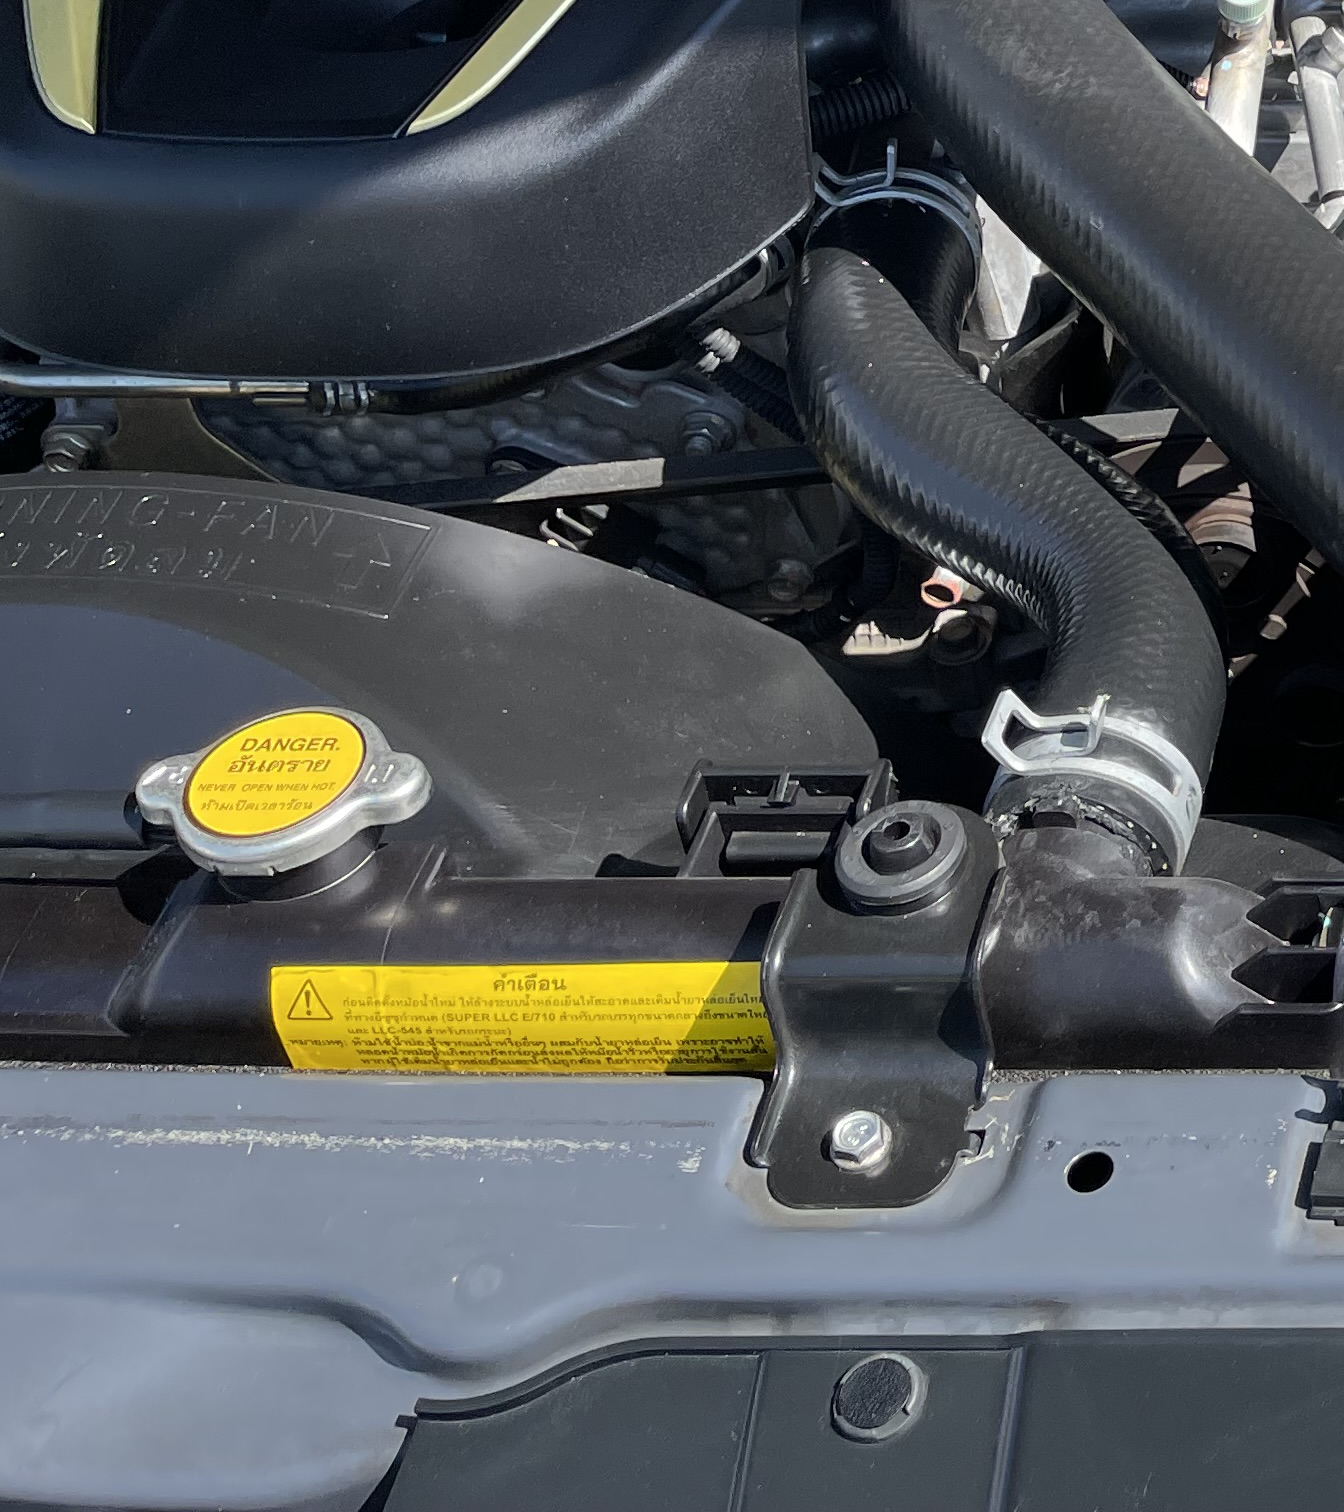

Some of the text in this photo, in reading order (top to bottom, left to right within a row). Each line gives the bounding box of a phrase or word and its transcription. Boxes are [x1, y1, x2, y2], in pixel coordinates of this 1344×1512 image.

[0, 490, 336, 546] NING-FAN
[240, 737, 341, 752] DANGER.
[227, 754, 332, 774] อันตราย
[197, 782, 237, 793] NEVER
[240, 782, 274, 793] OPEN
[275, 782, 308, 792] WHEN
[200, 798, 314, 813] ห้ามเปิดเวลาร้อน
[493, 973, 568, 992] คำเตือน
[343, 994, 456, 1008] ก่อนติดตั้งหม้อน้ำใหม่
[442, 1012, 491, 1024] (SUPER
[494, 1012, 519, 1023] LLC
[522, 1012, 556, 1023] E/710
[348, 1027, 369, 1035] และ
